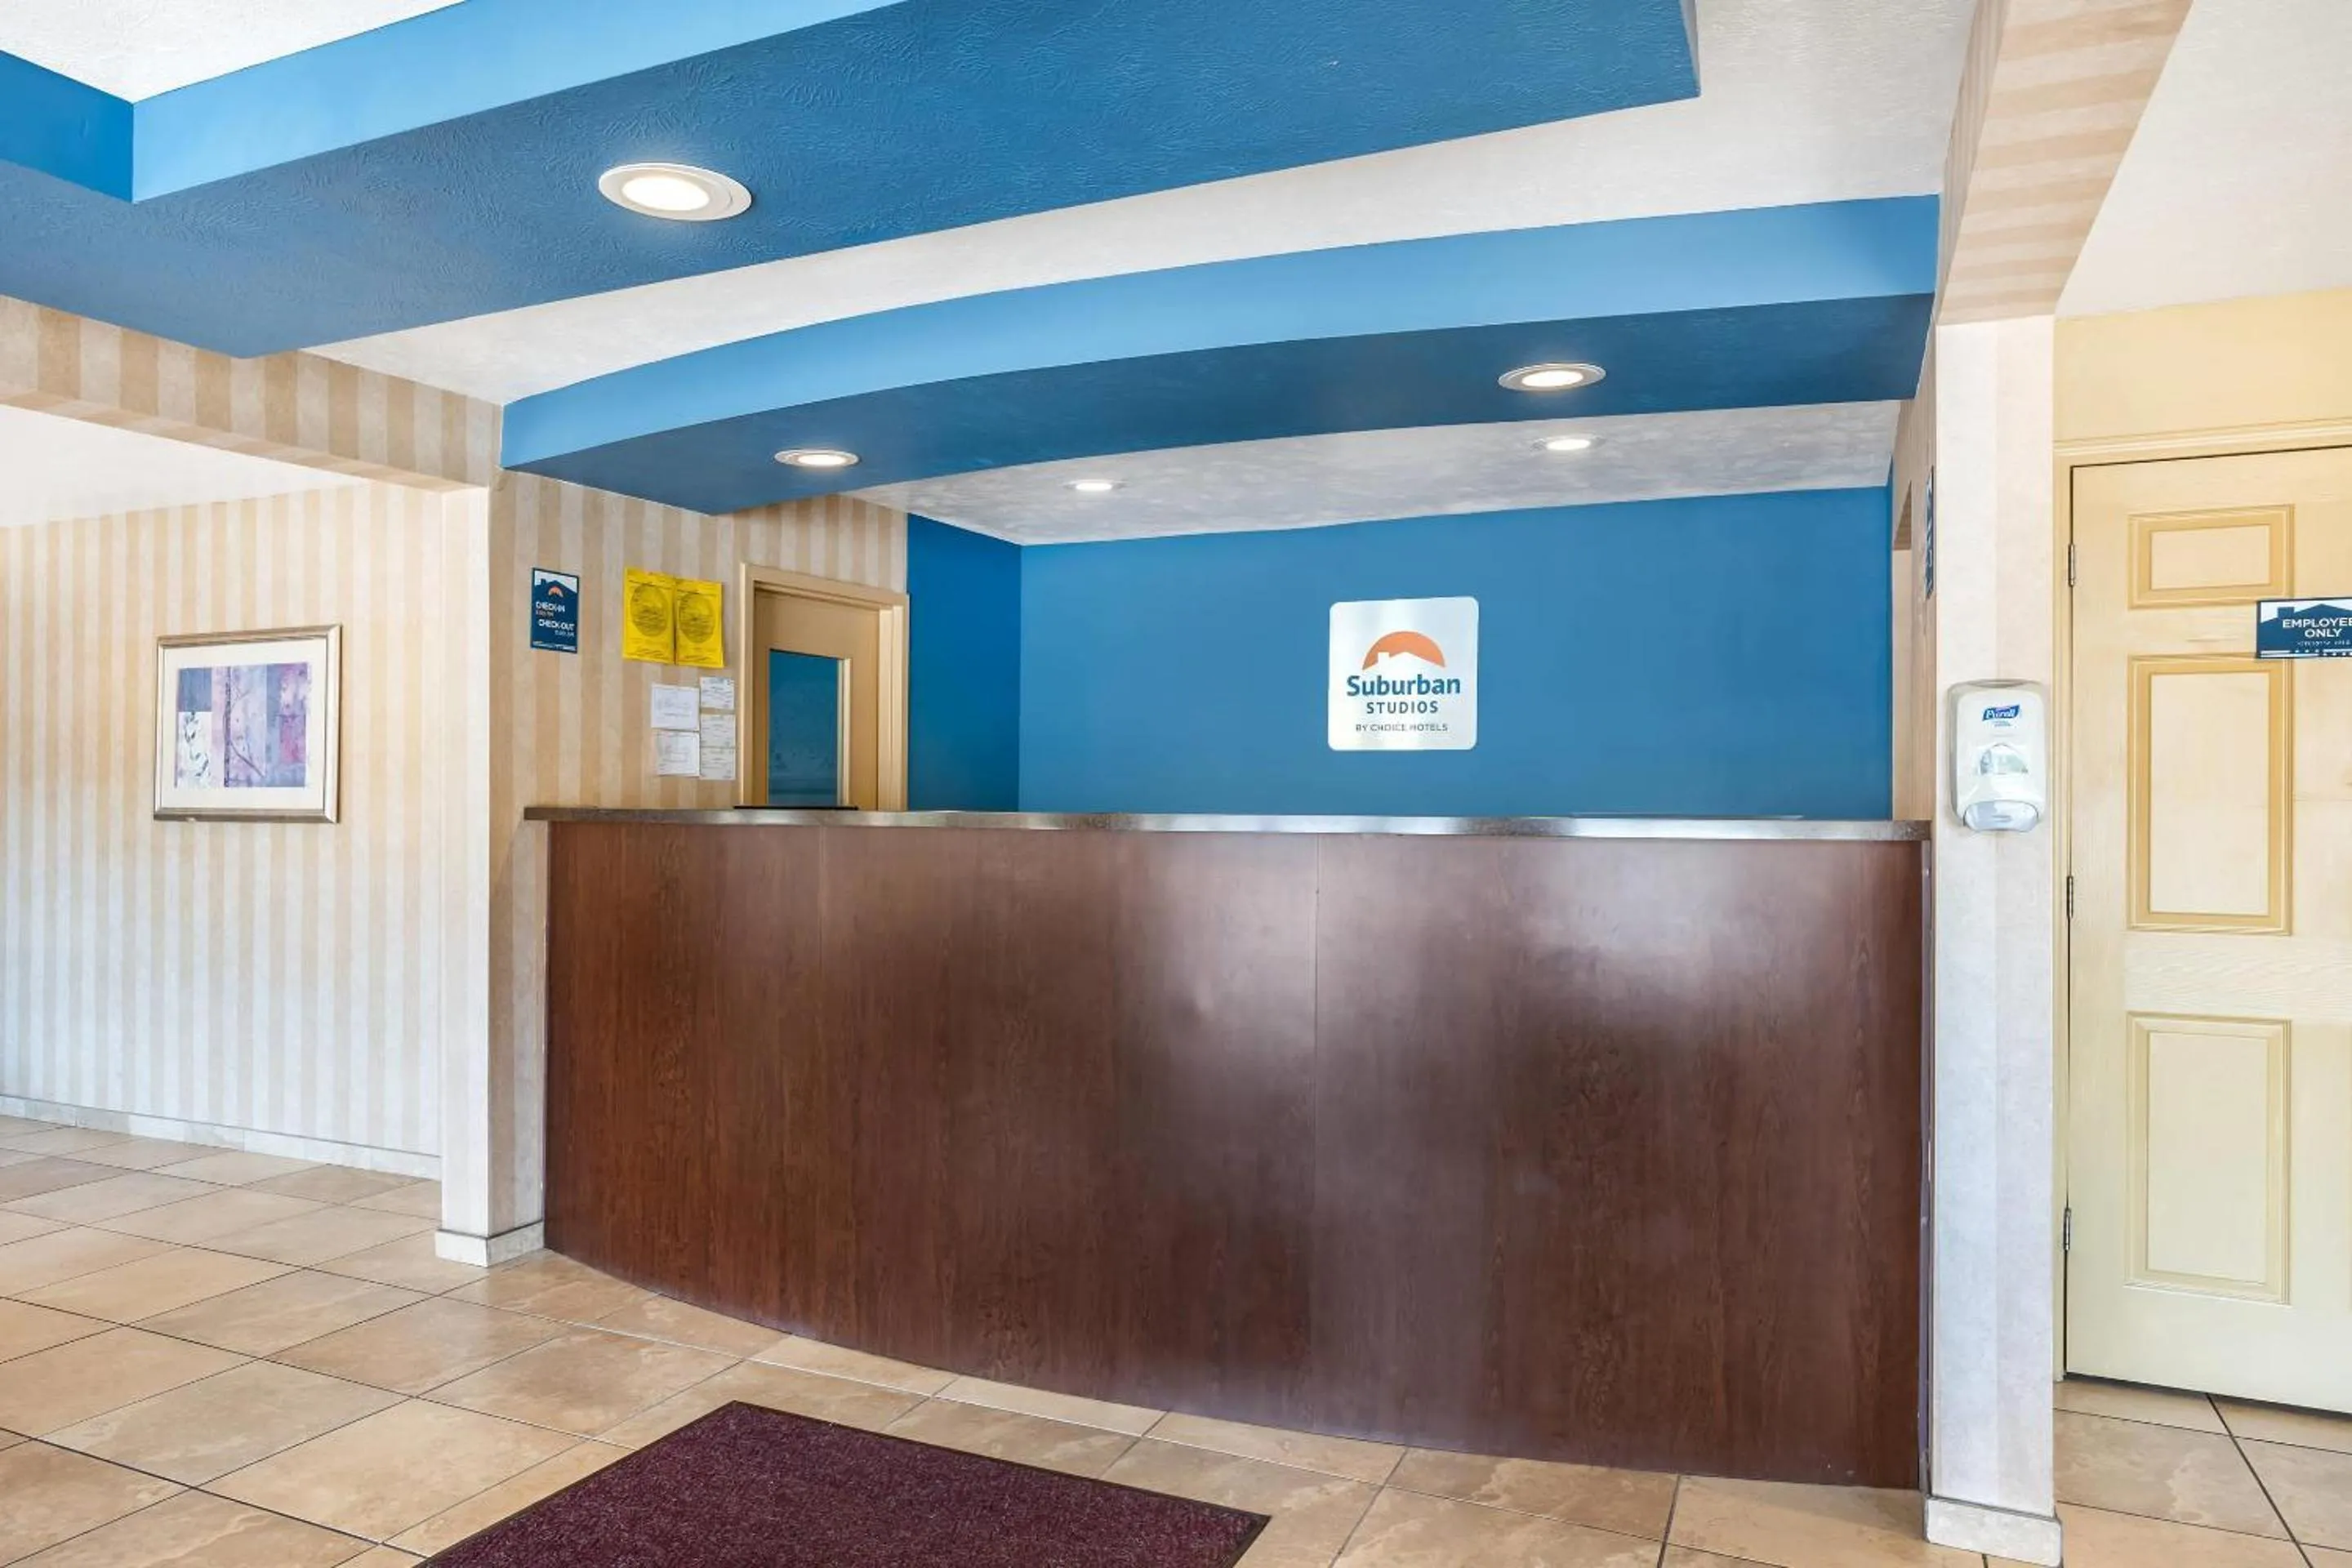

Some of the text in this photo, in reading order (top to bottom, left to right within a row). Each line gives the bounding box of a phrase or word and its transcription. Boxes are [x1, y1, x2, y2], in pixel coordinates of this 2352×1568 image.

[2305, 628, 2342, 637] ONLY
[1347, 674, 1460, 697] Suburban
[1366, 701, 1439, 714] STUDIOS
[1356, 724, 1448, 732] BY CHOICE HOTELS
